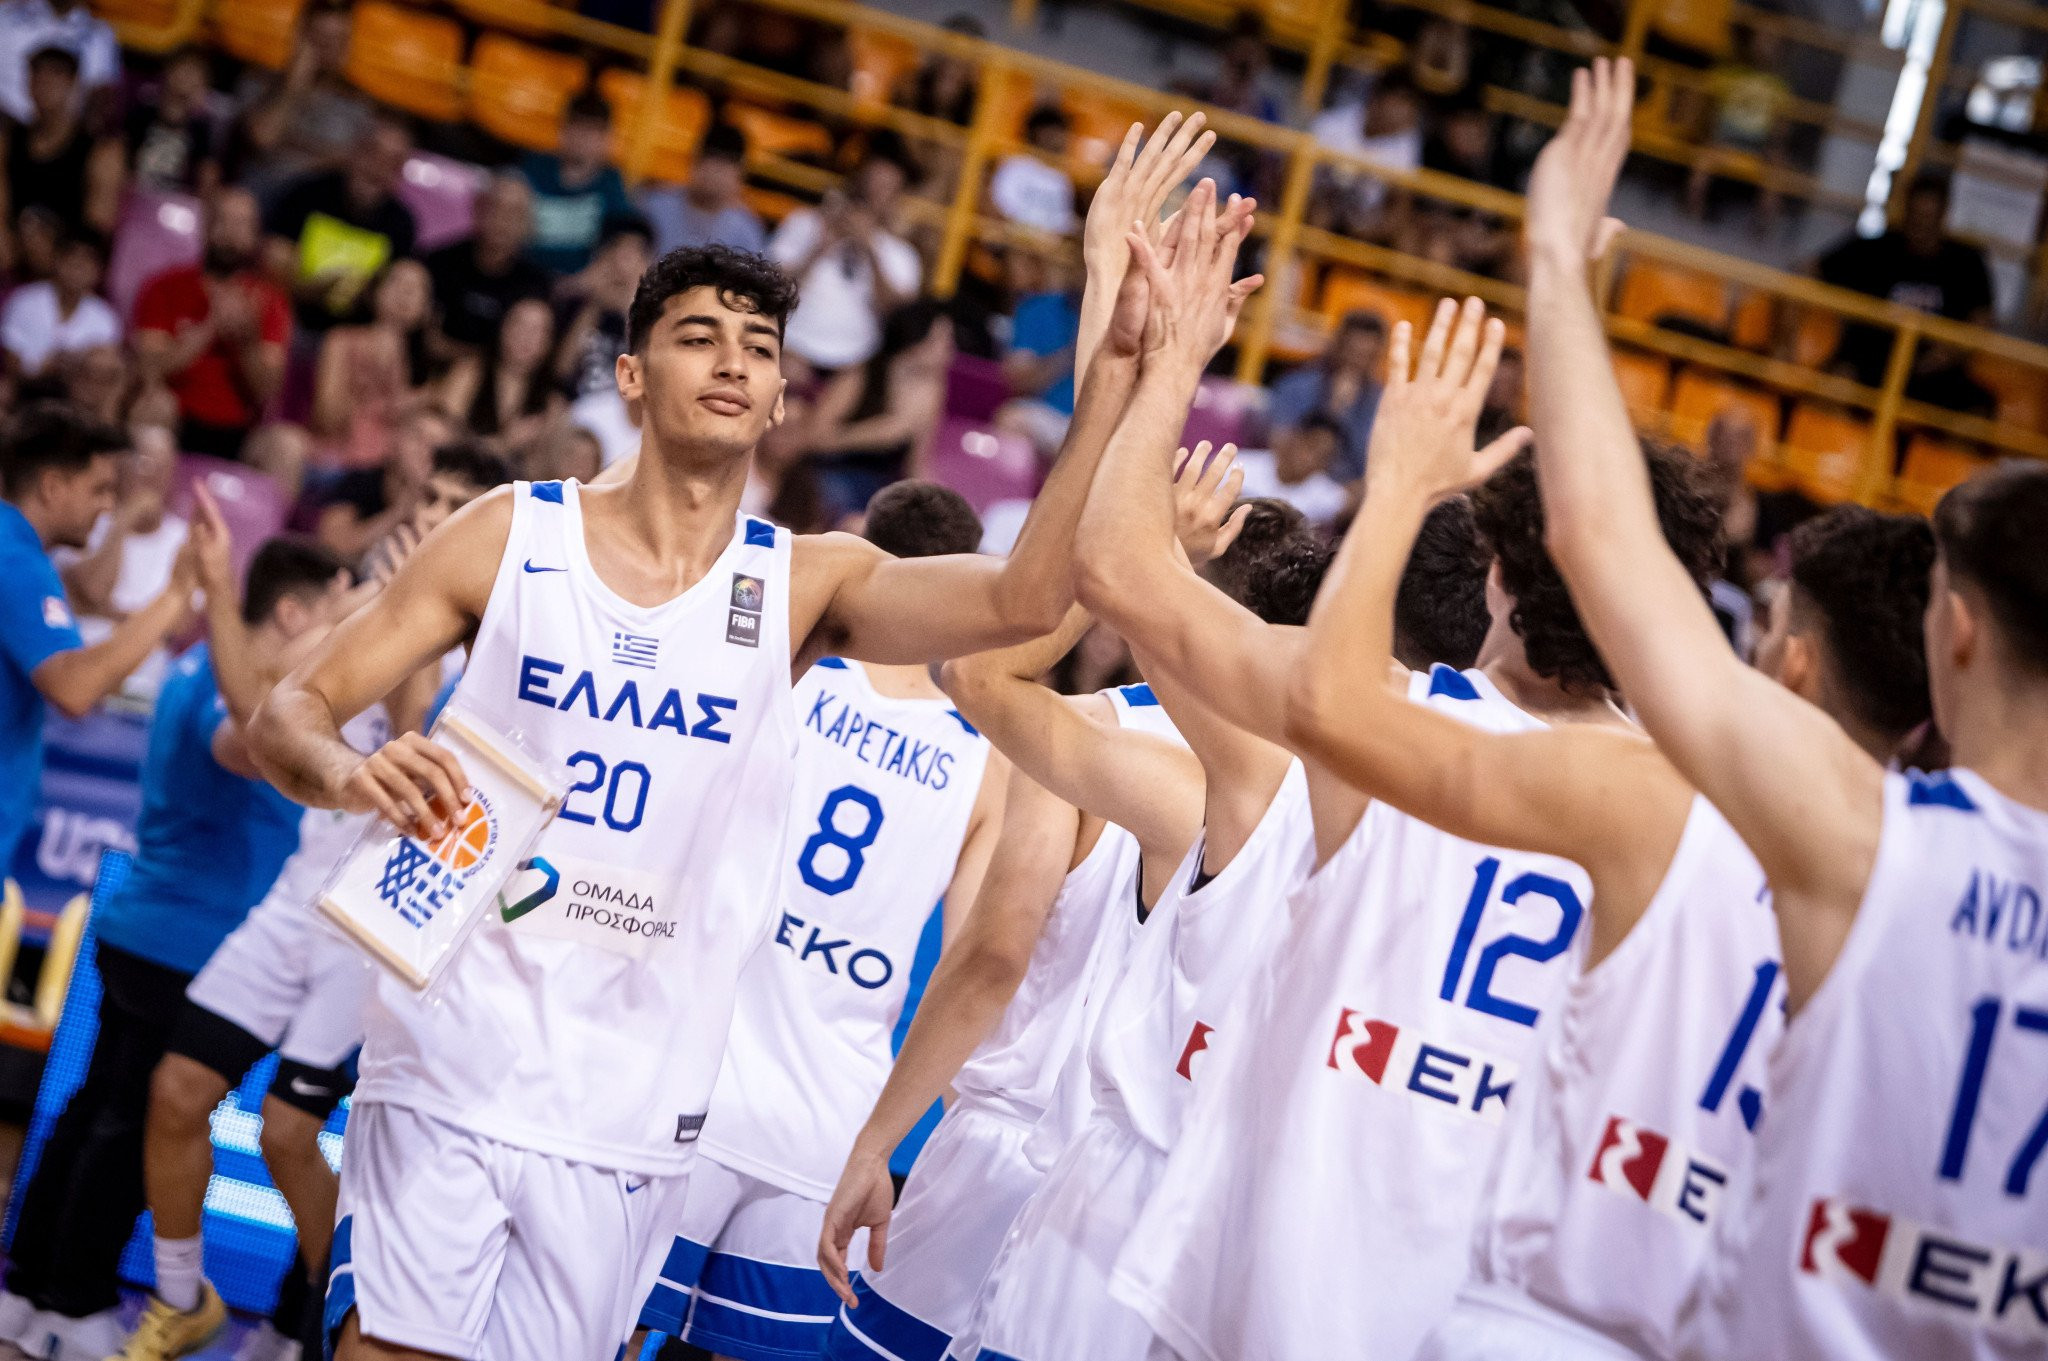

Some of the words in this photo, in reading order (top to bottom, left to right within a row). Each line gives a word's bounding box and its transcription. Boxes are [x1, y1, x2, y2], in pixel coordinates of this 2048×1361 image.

[731, 613, 756, 630] FIBA
[518, 654, 738, 744] ΕΛΛΑΣ
[805, 689, 955, 790] KAPETAKIS
[557, 750, 652, 832] 20
[798, 784, 884, 896] 8
[566, 902, 678, 938] ΠΡΟΣΦΟΡΑΣ
[572, 880, 655, 912] ΟΜΑΔΑ
[1949, 866, 2048, 960] AVD
[775, 909, 893, 989] EKO
[1438, 856, 1585, 1029] 12
[1938, 996, 2048, 1198] 17
